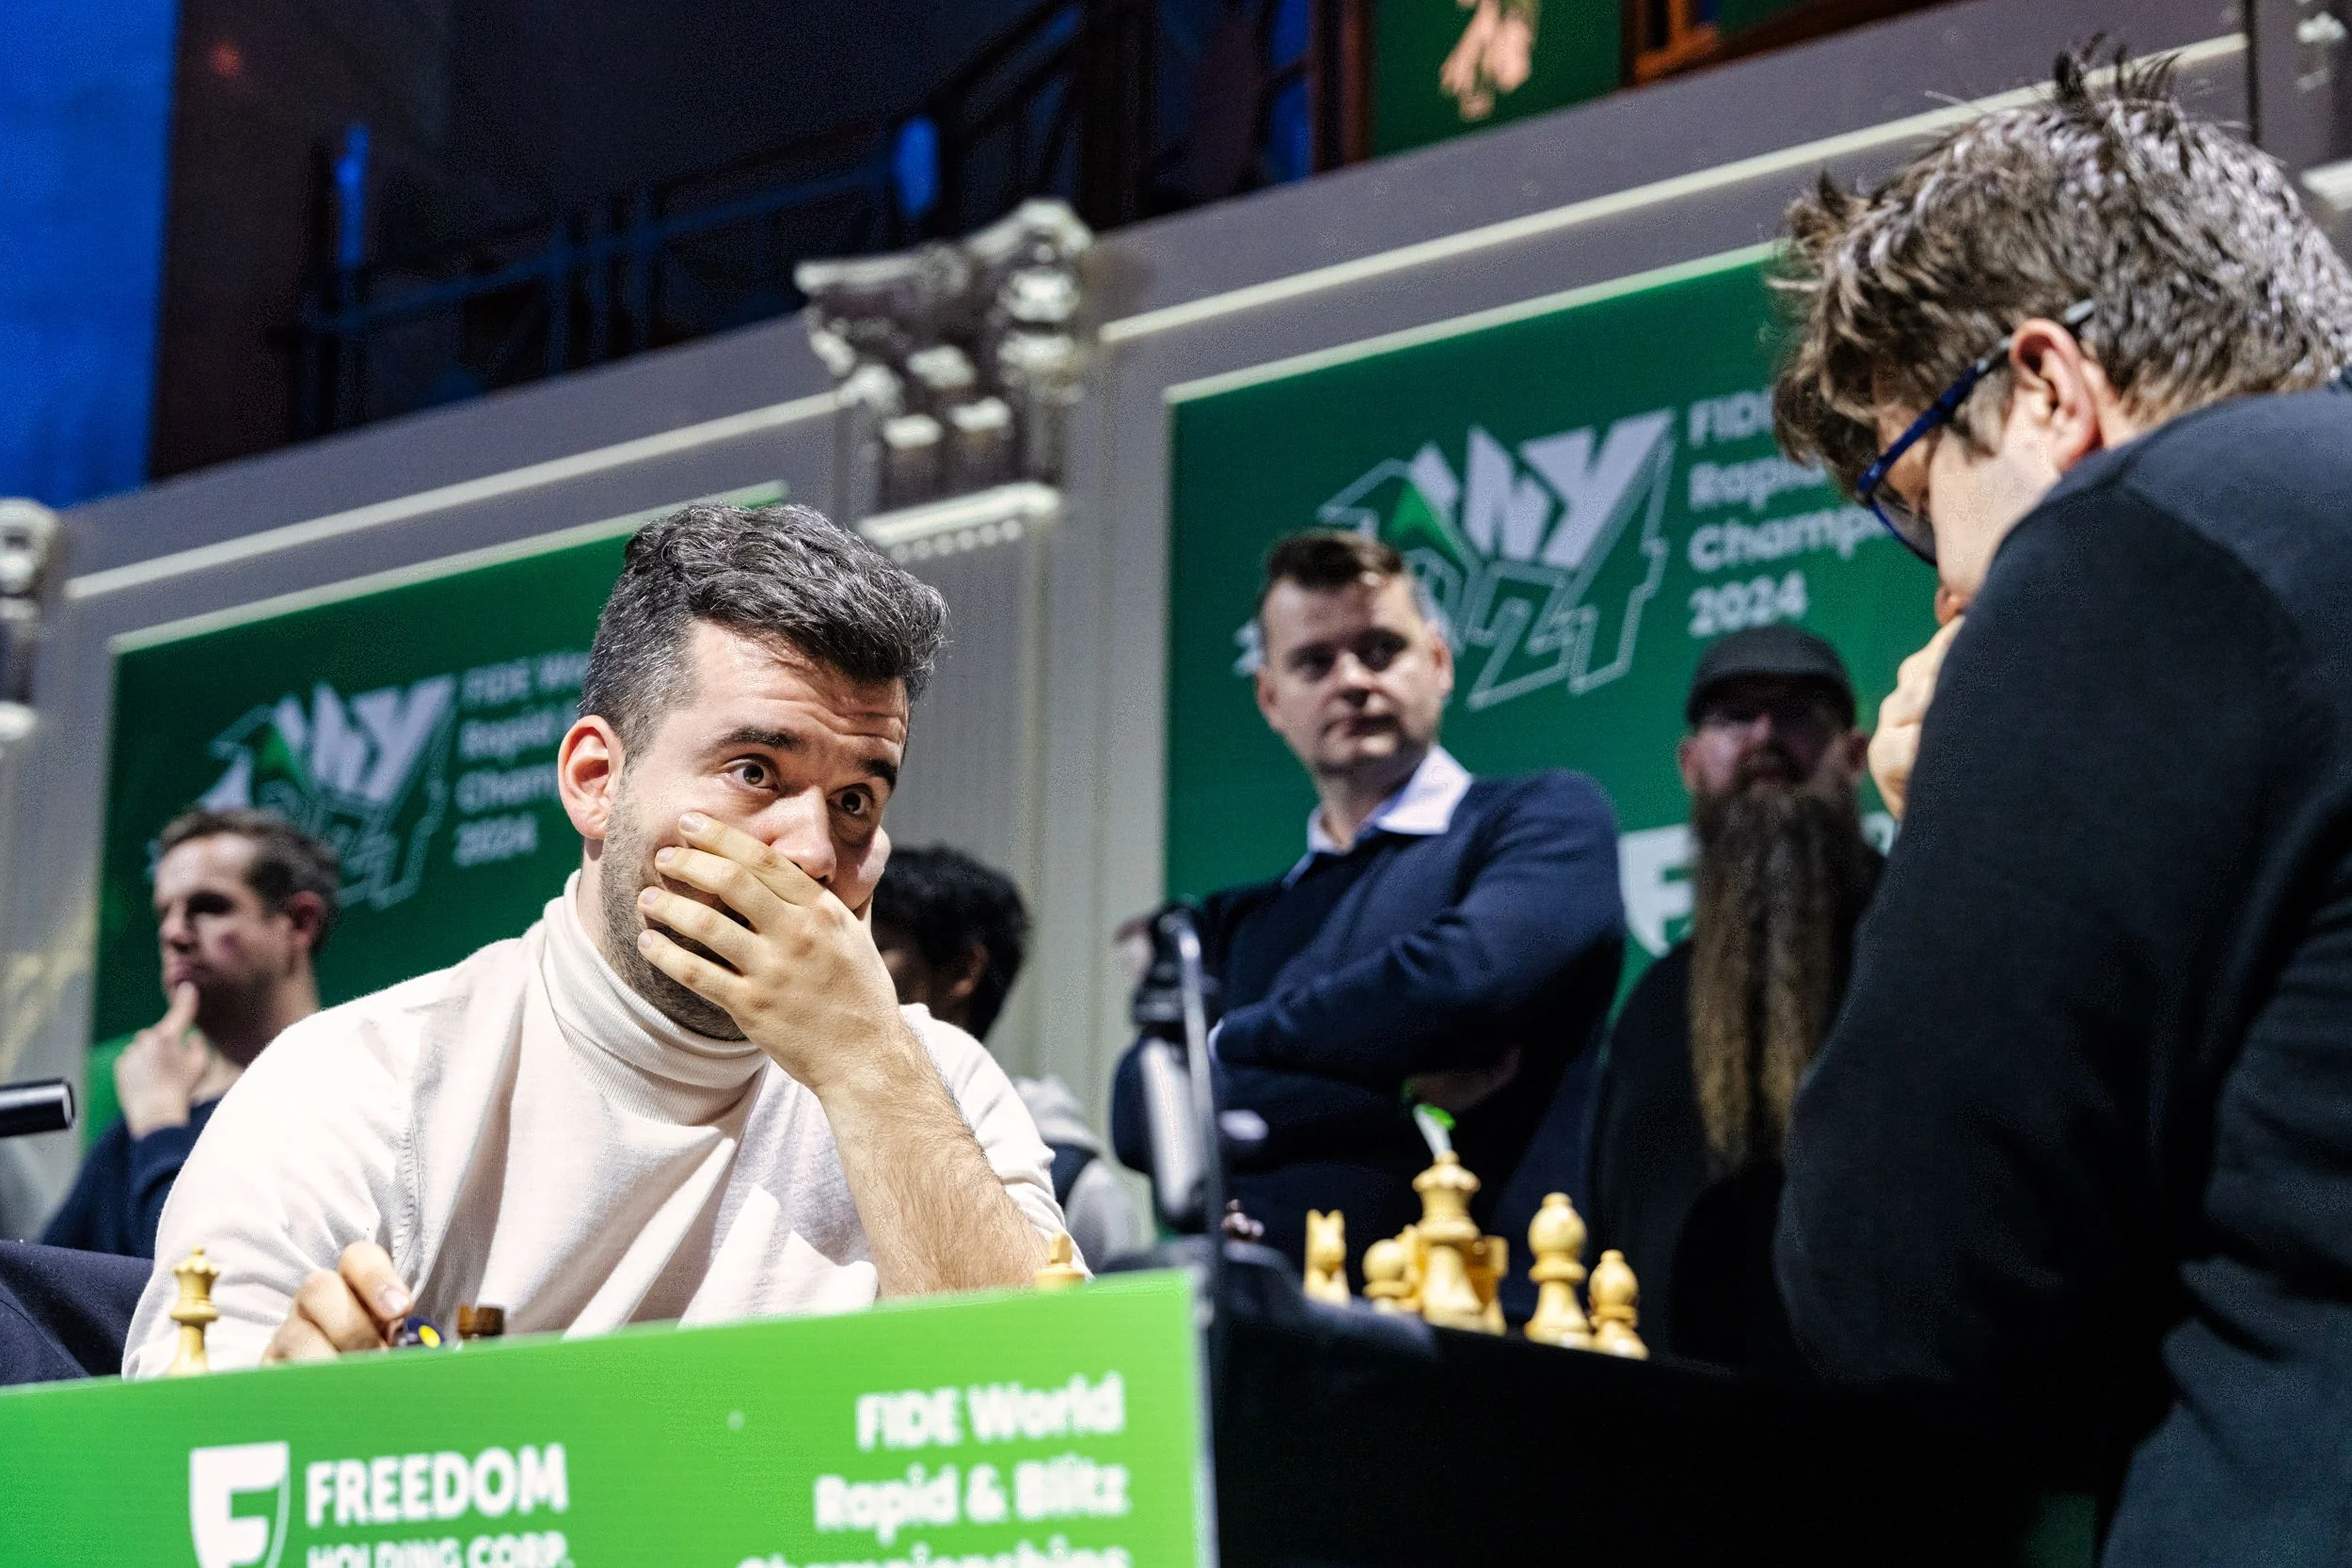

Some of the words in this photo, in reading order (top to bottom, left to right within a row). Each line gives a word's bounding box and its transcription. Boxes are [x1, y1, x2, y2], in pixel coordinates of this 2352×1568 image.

[1688, 504, 1884, 570] Champ
[1690, 570, 1806, 637] 2024
[856, 1388, 961, 1451] FIDE
[967, 1370, 1125, 1443] World
[306, 1443, 569, 1528] FREEDOM
[814, 1463, 959, 1545] Rapid
[965, 1463, 1006, 1524] &
[1013, 1454, 1131, 1521] Blitz
